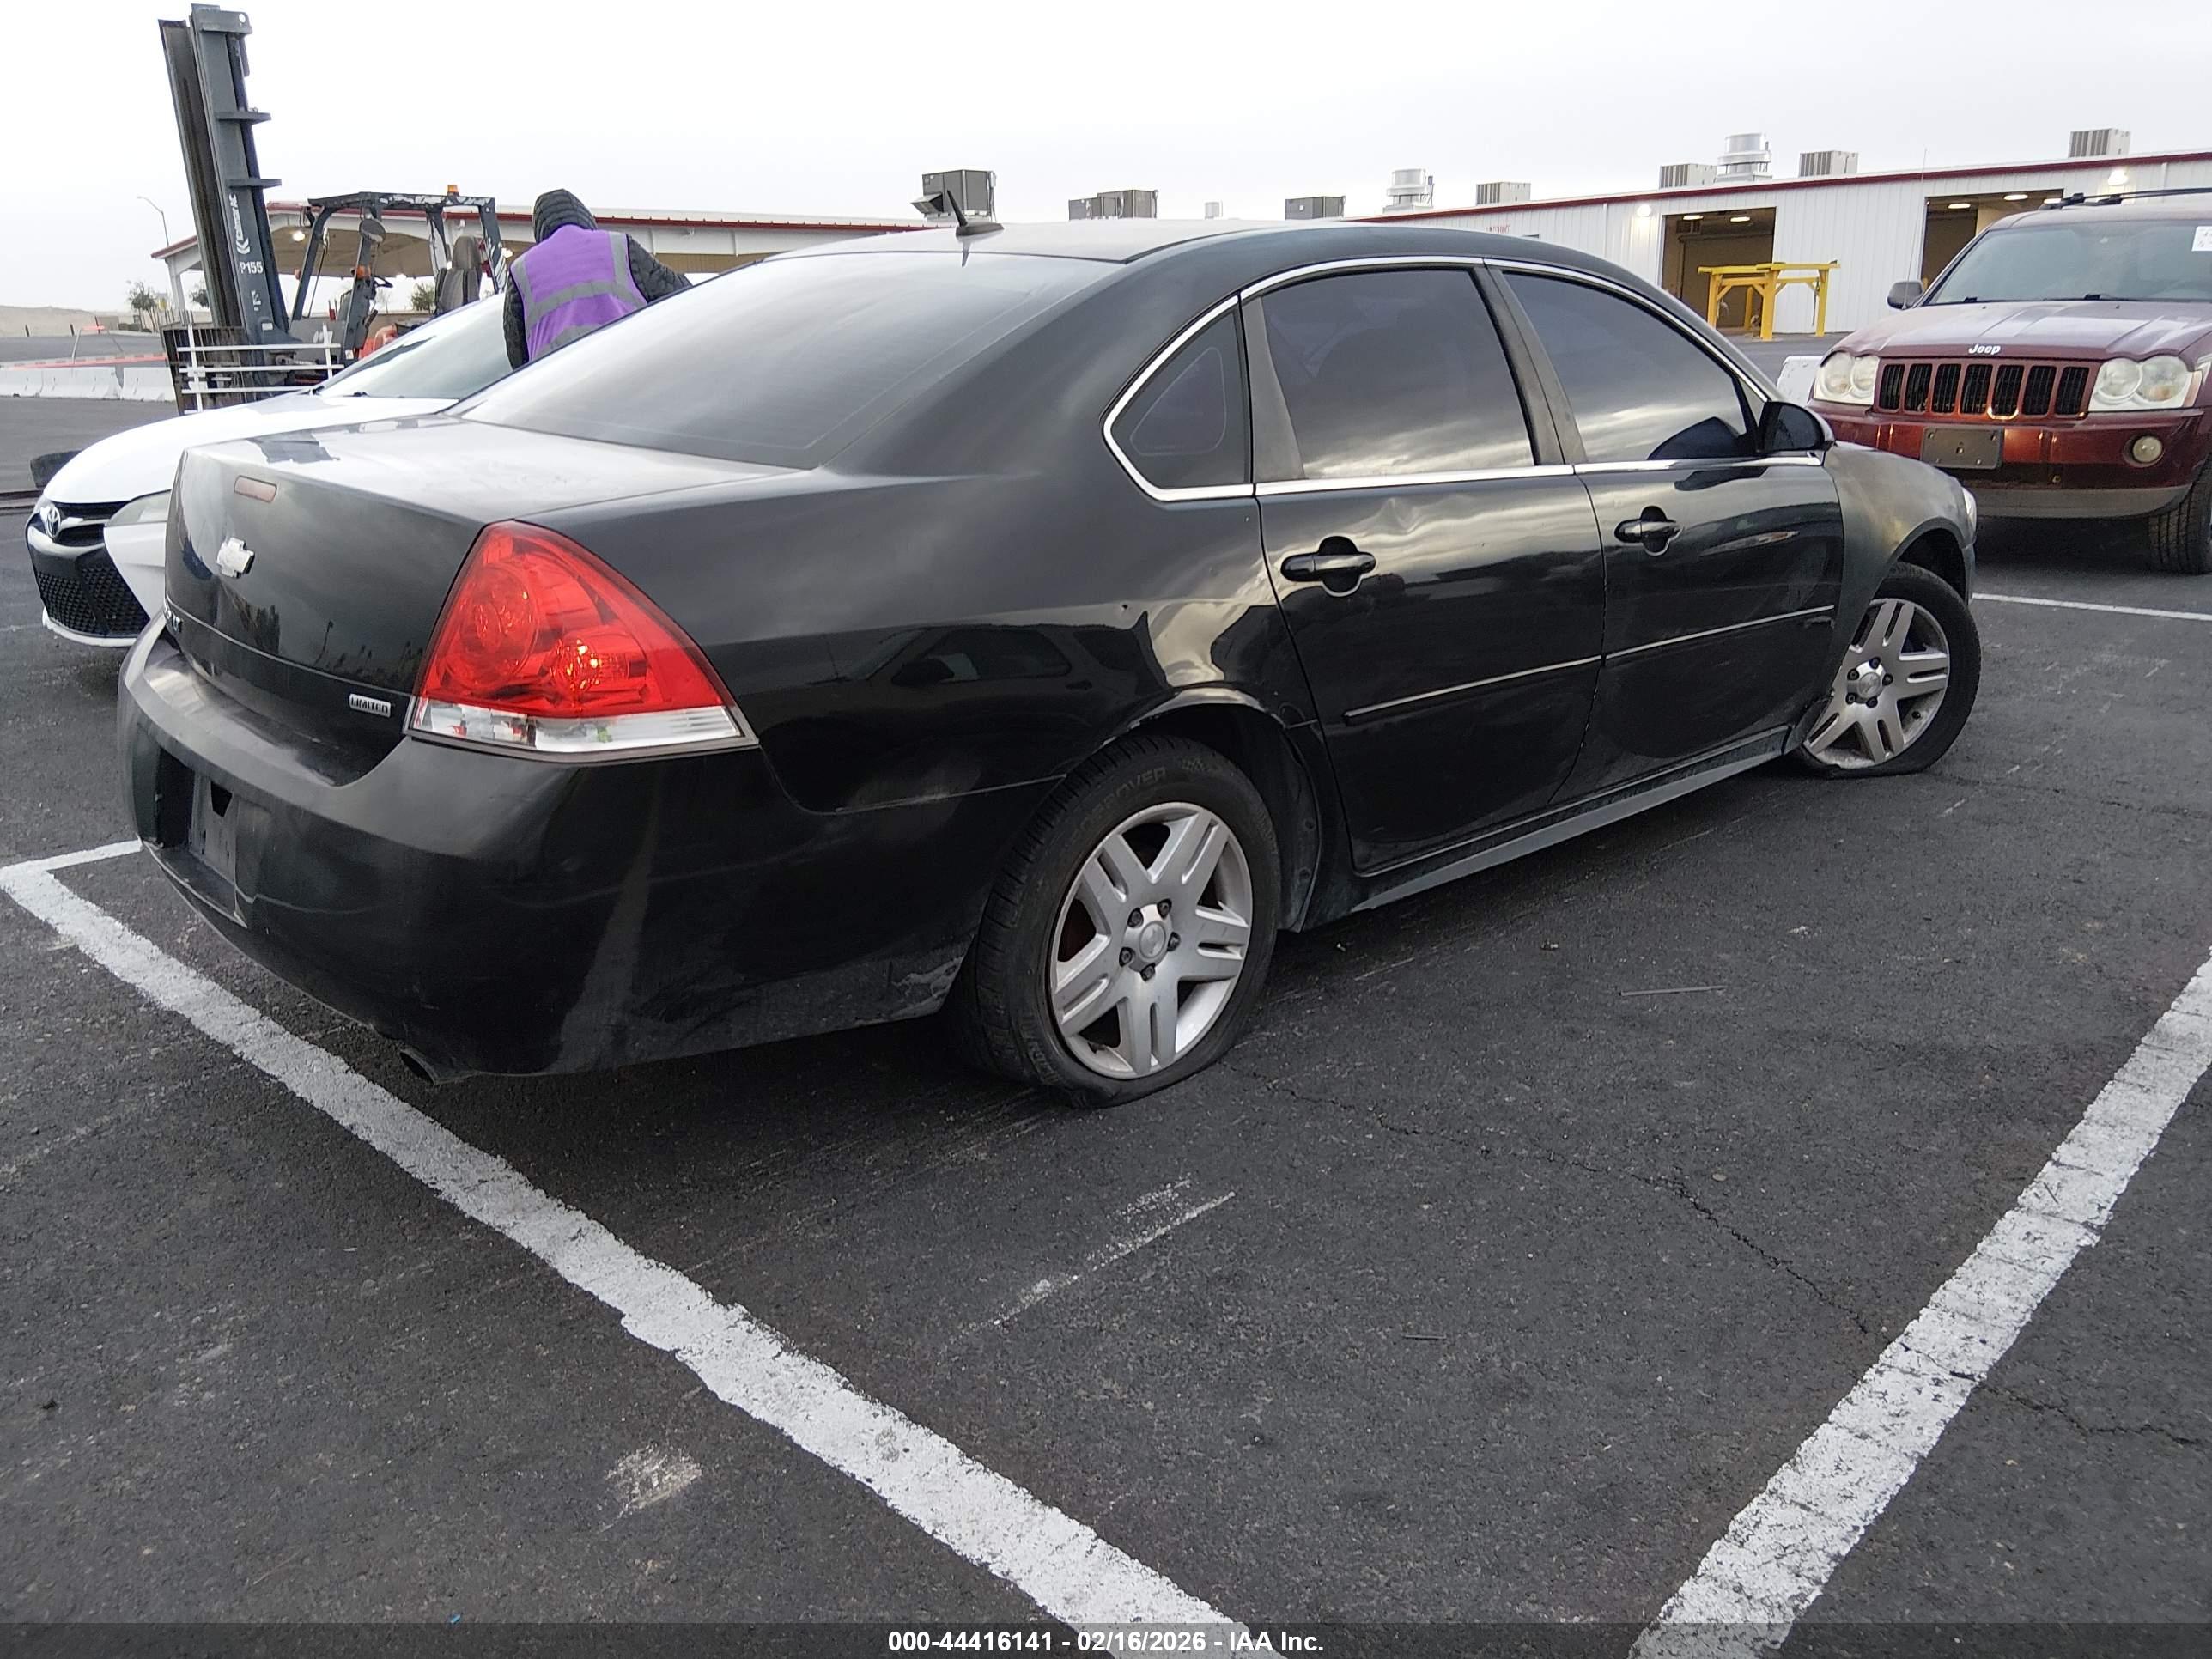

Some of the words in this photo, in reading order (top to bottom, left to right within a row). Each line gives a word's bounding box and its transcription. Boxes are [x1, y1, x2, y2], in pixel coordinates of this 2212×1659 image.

[240, 261, 264, 274] P155
[1968, 343, 2002, 356] Jeep
[350, 696, 390, 714] LIMITED
